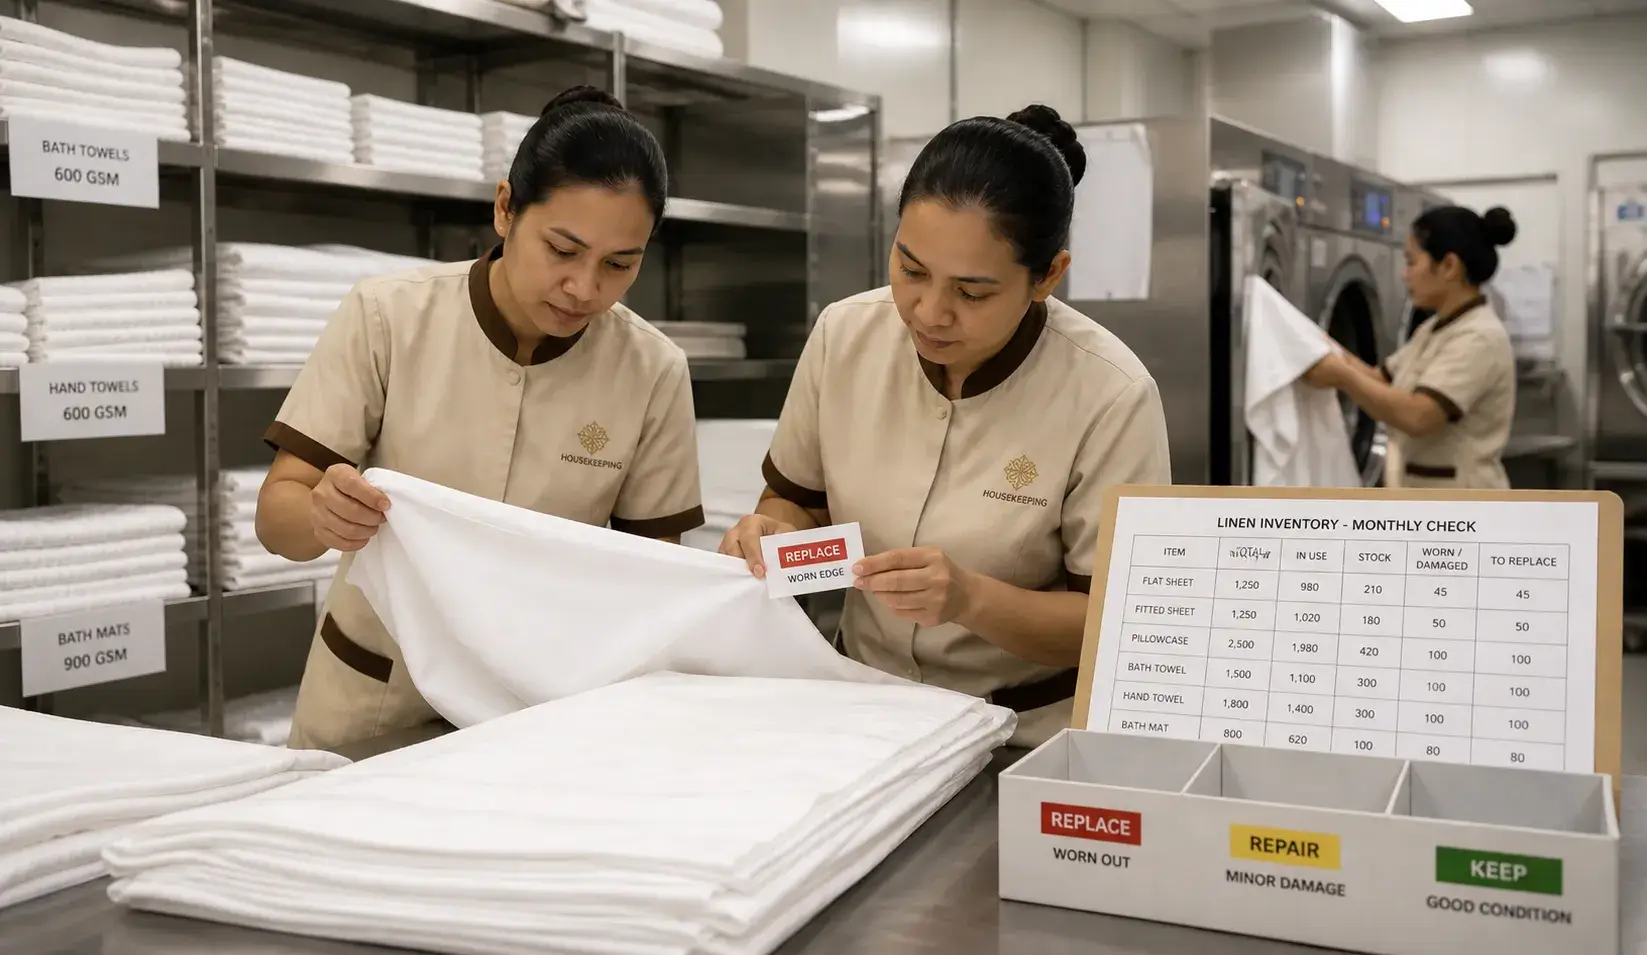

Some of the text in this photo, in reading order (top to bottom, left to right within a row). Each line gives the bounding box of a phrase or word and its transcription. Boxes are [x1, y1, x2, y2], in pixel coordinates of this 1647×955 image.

[42, 140, 129, 161] BATH TOWELS
[55, 167, 119, 186] 600 GSM
[49, 381, 139, 394] HAND TOWELS
[63, 405, 126, 421] 600 GSM
[560, 452, 623, 470] HOUSEKEEPING
[983, 488, 1047, 507] HOUSEKEEPING
[1218, 518, 1255, 528] LINEN
[1261, 518, 1339, 529] INVENTORY
[1353, 520, 1422, 531] MONTHLY
[1427, 521, 1476, 532] CHECK
[785, 544, 841, 563] REPLACE
[1164, 548, 1185, 556] ITEM
[1309, 552, 1327, 560] USE
[1422, 548, 1463, 557] WORN /
[1359, 553, 1391, 562] STOCK
[1491, 556, 1556, 566] TO REPLACE
[1417, 561, 1468, 570] DAMAGED
[788, 568, 844, 582] WORN EDGE
[1143, 577, 1194, 586] FLAT SHEET
[1236, 581, 1259, 589] 1,250
[1301, 583, 1319, 591] 980
[1364, 585, 1382, 594] 210
[1434, 587, 1447, 596] 45
[1516, 590, 1529, 599] 45
[1135, 605, 1195, 615] FITTED SHEET
[1232, 610, 1256, 619] 1,250
[1295, 613, 1320, 622] 1,020
[1363, 616, 1380, 625] 180
[1433, 619, 1446, 628] 50
[1516, 622, 1529, 631] 50
[58, 623, 130, 646] BATH MATS
[1132, 634, 1188, 645] PILLOWCASE
[1228, 639, 1254, 649] 2,500
[1293, 643, 1318, 653] 1,980
[1360, 647, 1379, 656] 420
[1429, 650, 1447, 660] 100
[64, 648, 127, 671] 900 GSM
[1512, 655, 1531, 665] 100
[1128, 663, 1186, 674] BATH TOWEL
[1227, 670, 1251, 679] 1,500
[1290, 674, 1315, 683] 1,100
[1357, 678, 1377, 687] 300
[1428, 682, 1446, 692] 100
[1510, 687, 1530, 697] 100
[1123, 692, 1184, 703] HAND TOWEL
[1224, 699, 1248, 709] 1,800
[1288, 704, 1313, 714] 1,400
[1355, 709, 1375, 719] 300
[1425, 714, 1444, 724] 100
[1122, 721, 1169, 732] BATH MAT
[1509, 720, 1529, 730] 100
[1224, 729, 1242, 739] 800
[1289, 735, 1307, 744] 620
[1355, 741, 1373, 750] 100
[1426, 746, 1440, 756] 80
[1511, 752, 1525, 763] 80
[1051, 811, 1131, 837] REPLACE
[1250, 836, 1319, 858] REPAIR
[1053, 848, 1130, 868] WORN OUT
[1471, 860, 1527, 881] KEEP
[1226, 870, 1345, 897] MINOR DAMAGE
[1426, 895, 1572, 924] GOOD CONDITION
